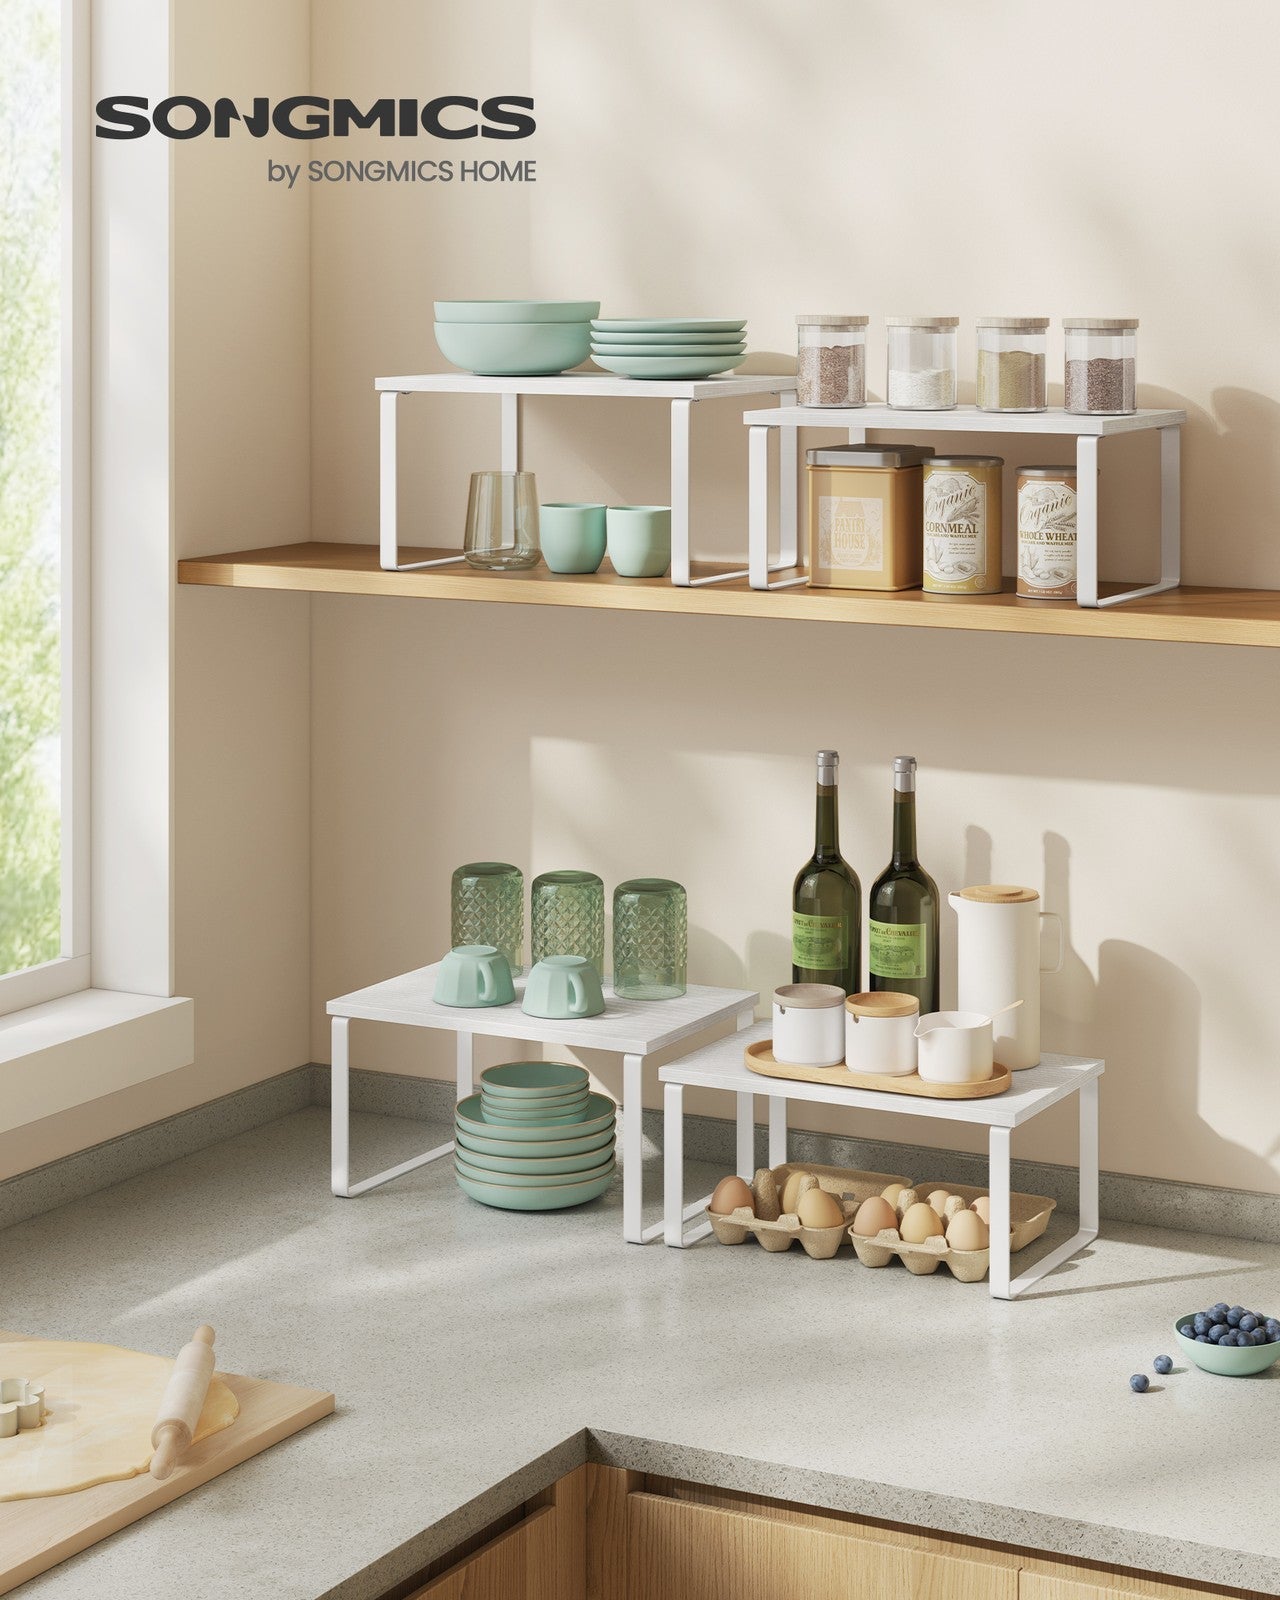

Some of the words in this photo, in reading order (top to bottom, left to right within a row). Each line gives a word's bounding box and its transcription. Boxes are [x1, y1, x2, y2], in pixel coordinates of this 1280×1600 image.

[925, 483, 977, 519] Organic
[1020, 493, 1072, 529] Organic
[925, 521, 979, 534] CORNMEAL
[1019, 531, 1044, 541] WHOLE
[832, 532, 866, 550] HOUSE
